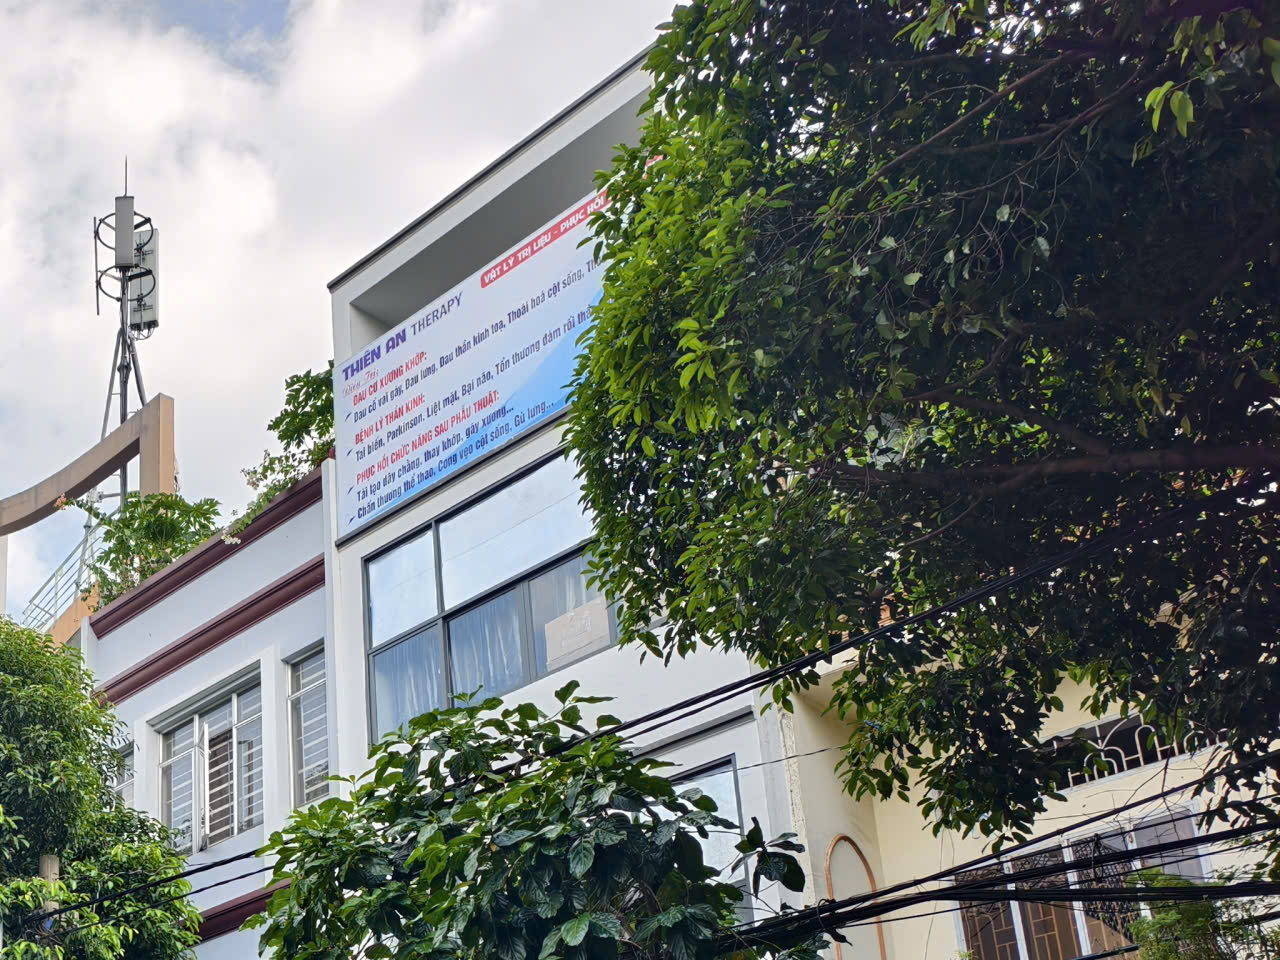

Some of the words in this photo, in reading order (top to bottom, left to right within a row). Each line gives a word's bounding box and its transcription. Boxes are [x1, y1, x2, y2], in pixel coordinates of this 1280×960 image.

[533, 232, 551, 251] LIỆU
[560, 209, 585, 233] PHỤC
[473, 327, 490, 346] kinh
[507, 303, 529, 324] Thoái
[547, 281, 561, 298] cột
[342, 345, 382, 381] THIÊN
[385, 328, 407, 354] AN
[411, 291, 463, 336] THERAPY
[380, 365, 403, 389] XƯƠNG
[355, 426, 374, 445] BỆNH
[356, 464, 376, 485] PHỤC
[390, 443, 410, 464] CHỨC
[434, 419, 449, 438] SAU
[424, 446, 440, 462] thay
[438, 452, 458, 472] Cong
[475, 432, 488, 450] cột
